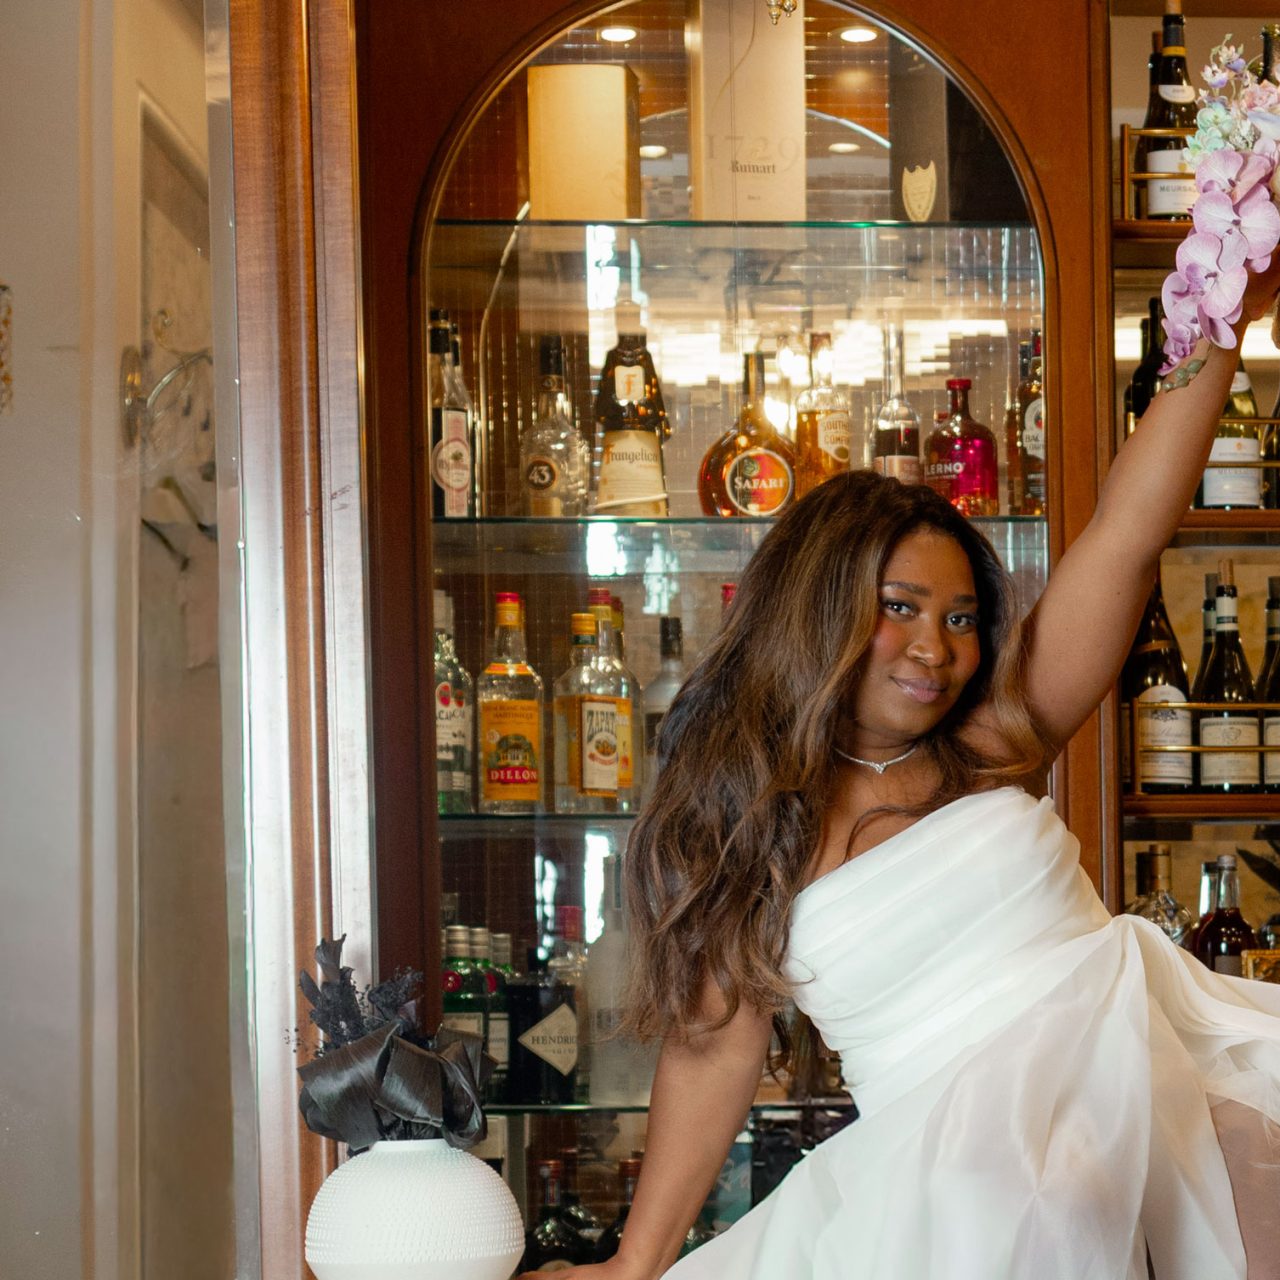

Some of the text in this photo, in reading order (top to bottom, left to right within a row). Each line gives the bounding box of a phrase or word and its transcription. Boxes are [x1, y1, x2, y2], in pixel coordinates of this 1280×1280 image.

[730, 161, 776, 174] Ruinart
[529, 463, 551, 484] 43
[733, 476, 785, 490] SAFARI
[586, 709, 617, 744] ZAPAT
[490, 769, 537, 780] DILLON
